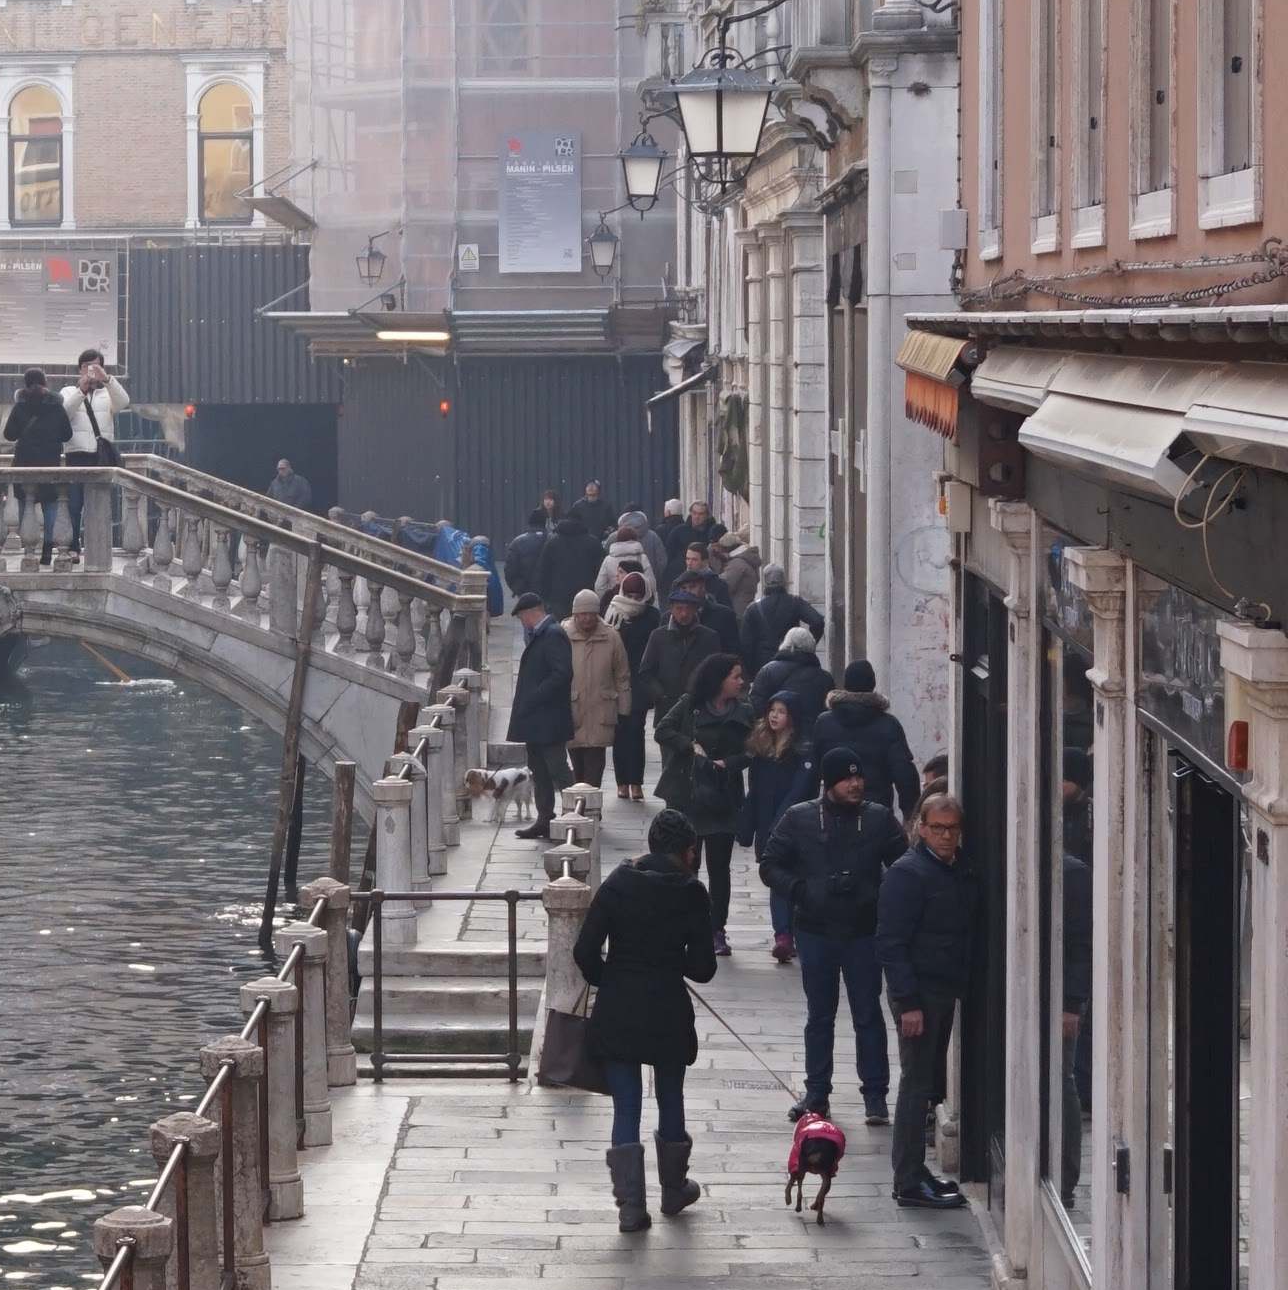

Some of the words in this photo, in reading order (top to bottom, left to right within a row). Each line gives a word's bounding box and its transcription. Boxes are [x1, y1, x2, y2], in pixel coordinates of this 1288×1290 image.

[506, 165, 536, 173] MANIN
[542, 165, 574, 173] PILSEN
[13, 262, 42, 270] PILSEN
